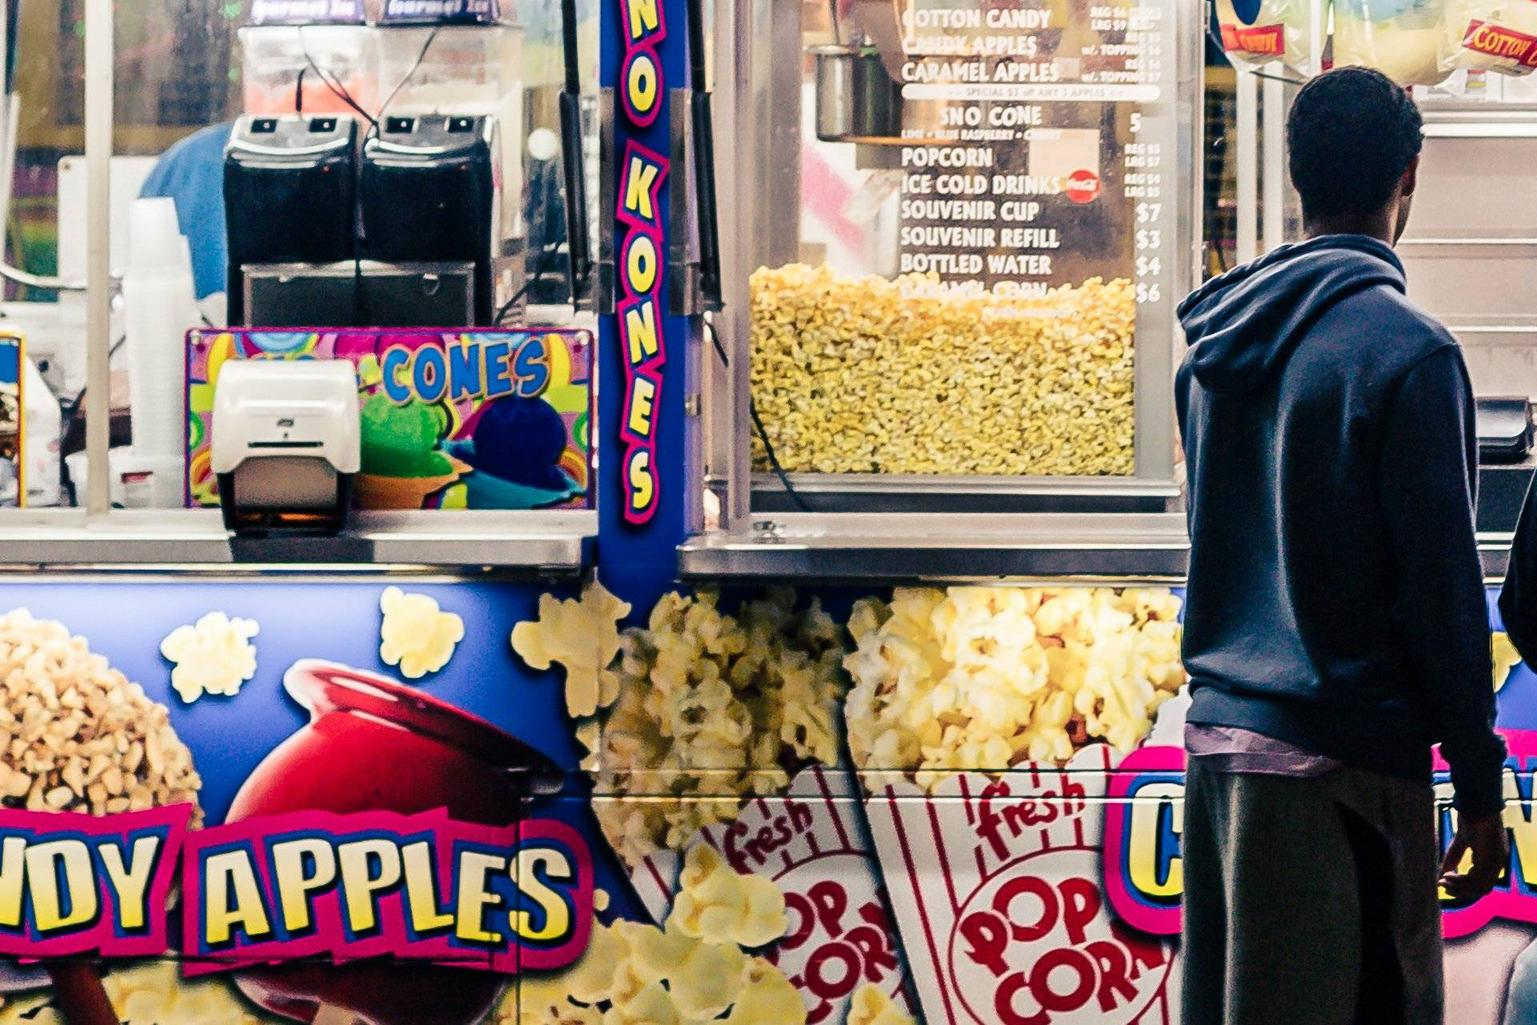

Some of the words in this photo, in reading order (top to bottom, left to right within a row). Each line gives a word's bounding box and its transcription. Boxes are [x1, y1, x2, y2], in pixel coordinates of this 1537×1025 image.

[901, 8, 980, 28] COTTON
[986, 8, 1052, 29] CANDY
[972, 35, 1037, 58] APPLES
[1472, 26, 1532, 56] COTTON
[901, 62, 989, 82] CARAMEL
[993, 62, 1060, 82] APPLES
[940, 106, 981, 126] SNO
[988, 105, 1042, 126] CONE
[1129, 112, 1141, 132] 5
[901, 147, 993, 167] POPCORN
[901, 175, 931, 194] ICE
[936, 174, 988, 194] COLD
[992, 175, 1060, 195] DRINKS
[901, 199, 996, 220] SOUVENIR
[1000, 200, 1040, 222] CUP
[1135, 202, 1162, 223] $7
[900, 227, 996, 247] SOUVENIR
[1000, 228, 1060, 249] REFILL
[1135, 229, 1161, 250] $3
[900, 253, 983, 274] BOTTLED
[987, 254, 1052, 274] WATER
[1135, 255, 1161, 276] $4
[1135, 282, 1161, 303] $6
[624, 155, 661, 510] KONES
[381, 338, 551, 406] CONES
[976, 774, 1086, 862] fresh
[724, 798, 813, 876] fresh
[205, 837, 572, 945] APPLES
[960, 876, 1102, 978] POP
